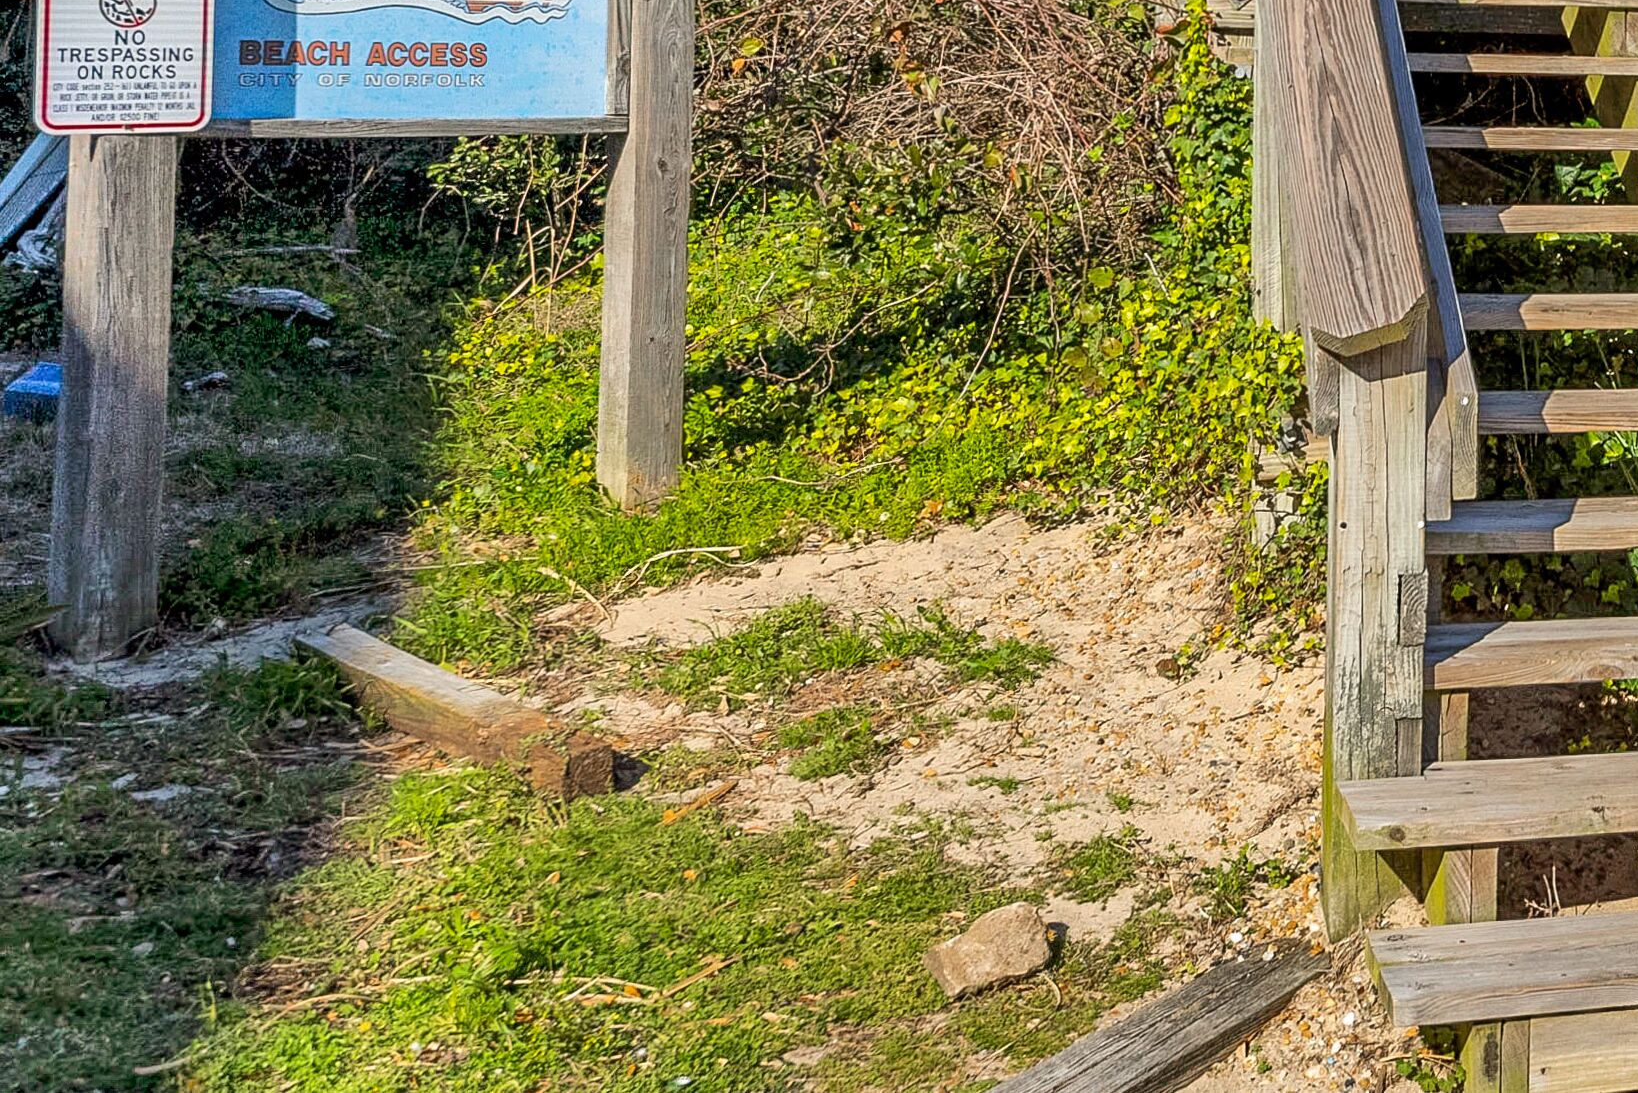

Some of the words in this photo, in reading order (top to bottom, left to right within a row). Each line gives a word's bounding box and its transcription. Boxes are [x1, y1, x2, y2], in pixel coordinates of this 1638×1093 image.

[114, 30, 146, 46] NO
[57, 47, 194, 63] TRESPASSING
[239, 39, 350, 66] BEACH
[365, 42, 488, 67] ACCESS
[77, 65, 104, 80] ON
[112, 64, 177, 80] ROCKS
[239, 73, 302, 87] CITY
[318, 73, 351, 87] OF
[364, 74, 486, 87] NORFOLK
